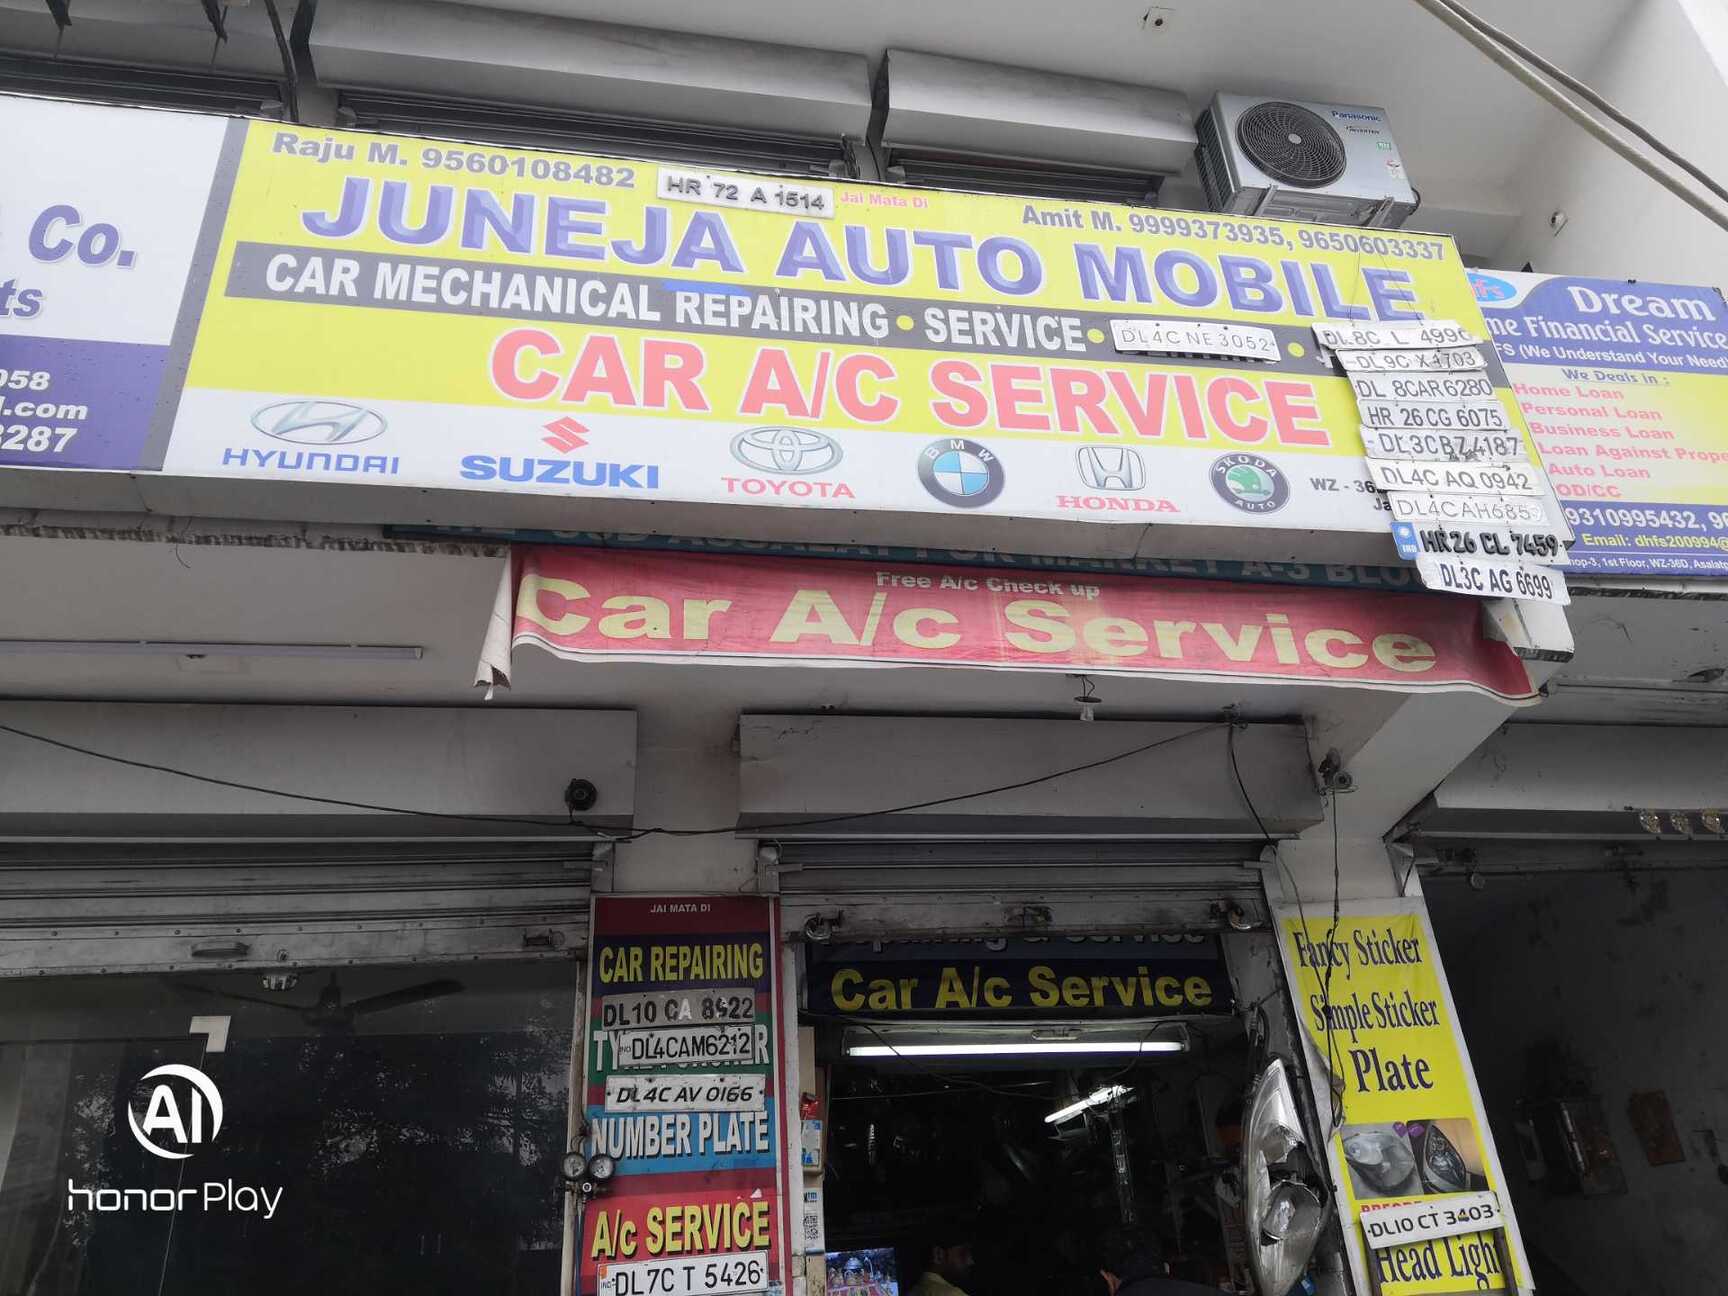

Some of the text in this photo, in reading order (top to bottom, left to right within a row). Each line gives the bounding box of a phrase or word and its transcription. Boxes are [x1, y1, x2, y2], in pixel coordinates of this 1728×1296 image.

[273, 132, 635, 188] Raju M. 9560108482
[666, 175, 825, 211] HR 72 A 1514
[868, 193, 909, 209] Mata
[912, 195, 929, 210] Di
[28, 204, 136, 269] Co.
[1022, 205, 1083, 231] Amit
[1092, 211, 1122, 233] M.
[1297, 229, 1445, 262] 9650603337
[302, 176, 1424, 321] JUNEJA AUTO MOBILE
[0, 278, 43, 317] ts
[266, 253, 1087, 353] CAR MECHANICAL REPAIRING SERVICE
[1567, 285, 1717, 321] Dream
[1485, 316, 1522, 336] me
[1523, 314, 1640, 343] Financial
[1519, 344, 1551, 360] (We
[1553, 345, 1646, 364] Understand
[1649, 351, 1684, 366] Your
[491, 327, 1332, 448] CAR A/C SERVICE
[1561, 368, 1590, 381] We
[1595, 370, 1639, 384] Deals
[1513, 383, 1625, 401] Home Loan
[1368, 406, 1394, 427] HR
[1456, 407, 1503, 428] 6075
[1520, 402, 1664, 421] Personal Loan
[0, 424, 78, 453] 287
[1529, 421, 1675, 440] Business Loan
[222, 446, 400, 475] HYUNDAI
[1216, 456, 1278, 478] SKODA
[1536, 441, 1728, 464] Loan Against Prope
[460, 454, 660, 489] SUZUKI
[1309, 477, 1340, 491] WZ
[1354, 480, 1377, 494] 36
[1445, 470, 1478, 489] AQ
[1480, 471, 1533, 490] 0942
[1548, 463, 1651, 479] Auto Loan
[721, 475, 857, 499] TOYOTA
[1554, 483, 1623, 499] OD/CC
[1055, 494, 1181, 513] HONDA
[1234, 499, 1277, 510] AUTO
[1373, 497, 1393, 511] Ja
[1582, 533, 1632, 547] Email:
[876, 571, 1101, 601] Free A/c Check up
[1440, 563, 1553, 599] DL3C AG 6699
[516, 574, 1437, 673] Car A/c Service
[650, 902, 712, 914] JAI MATA DI
[1353, 928, 1423, 967] Sticker
[600, 942, 764, 984] CAR REPAIRING
[831, 966, 1214, 1011] Car A/c Service
[603, 1001, 657, 1028] DL10
[1310, 990, 1440, 1044] Simple Sticker
[1348, 1047, 1434, 1093] Plate
[674, 1086, 703, 1103] AV
[591, 1111, 770, 1160] NUMBER PLATE
[591, 1201, 771, 1259] A/c SERVICE
[1418, 1212, 1440, 1230] CT
[683, 1266, 696, 1291] T
[704, 1260, 761, 1289] 5426
